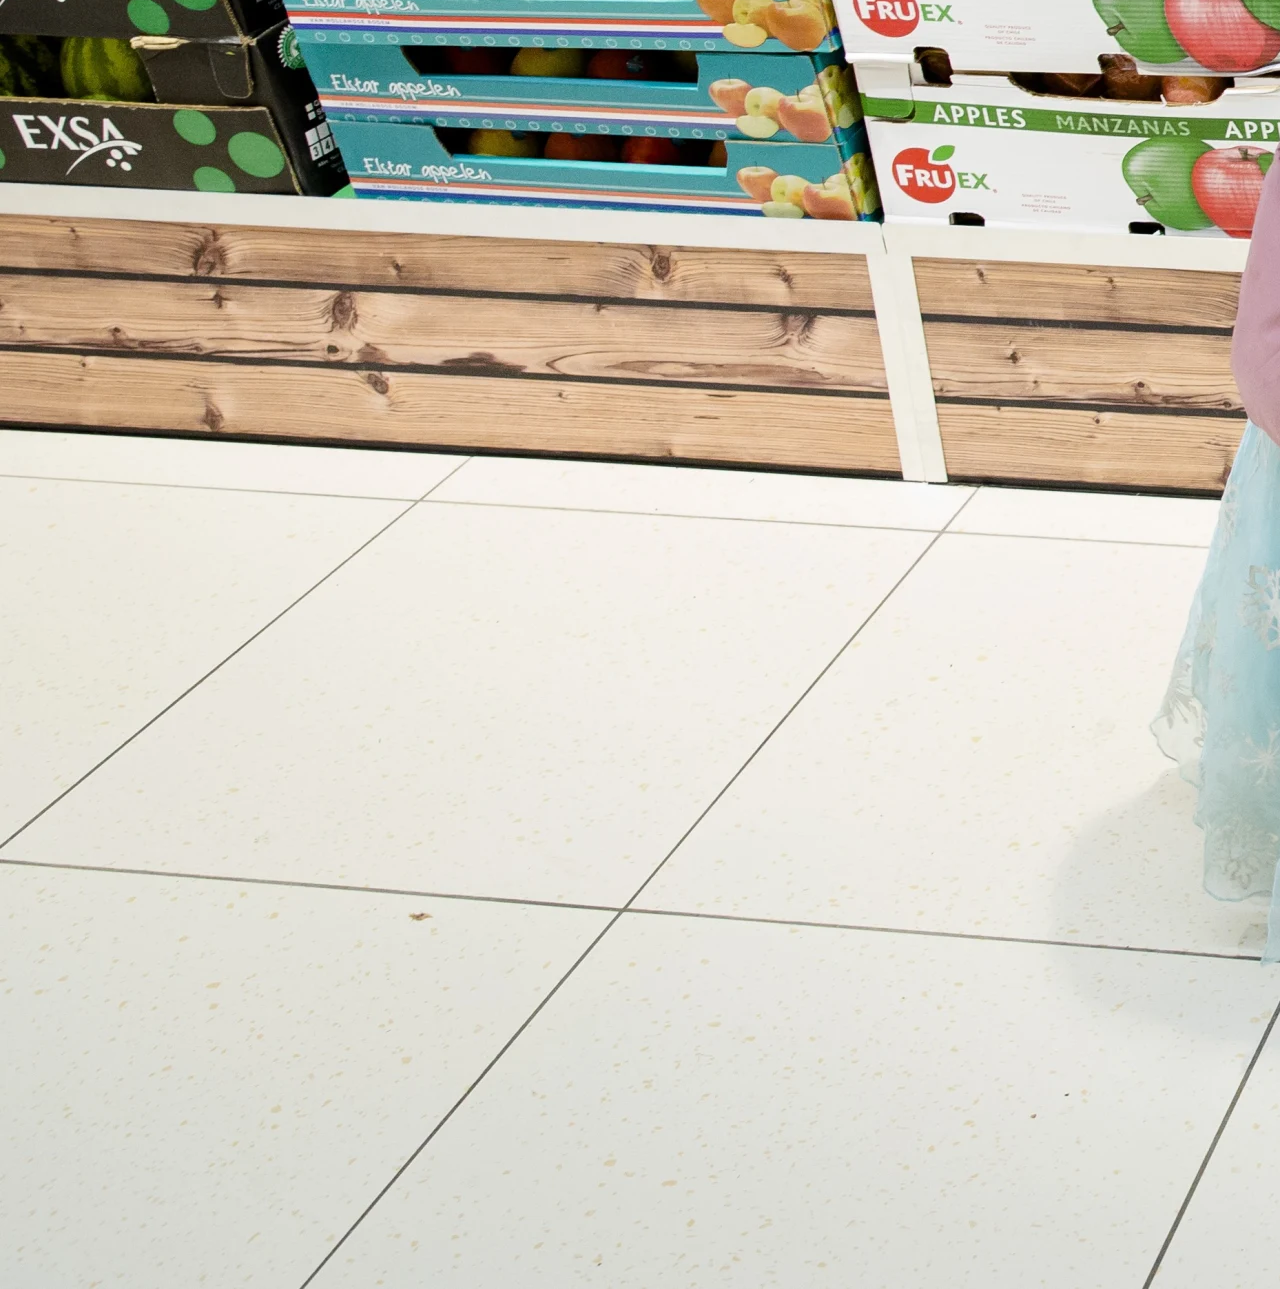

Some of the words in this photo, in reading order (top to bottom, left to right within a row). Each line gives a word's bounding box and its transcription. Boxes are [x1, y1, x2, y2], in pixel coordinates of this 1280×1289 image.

[330, 74, 380, 94] Elstar
[389, 80, 463, 101] appelen
[13, 114, 139, 155] EXSA
[933, 104, 1027, 128] APPLES
[1054, 114, 1191, 137] MANZANAS
[364, 156, 411, 177] Elstar
[422, 161, 492, 183] appelen
